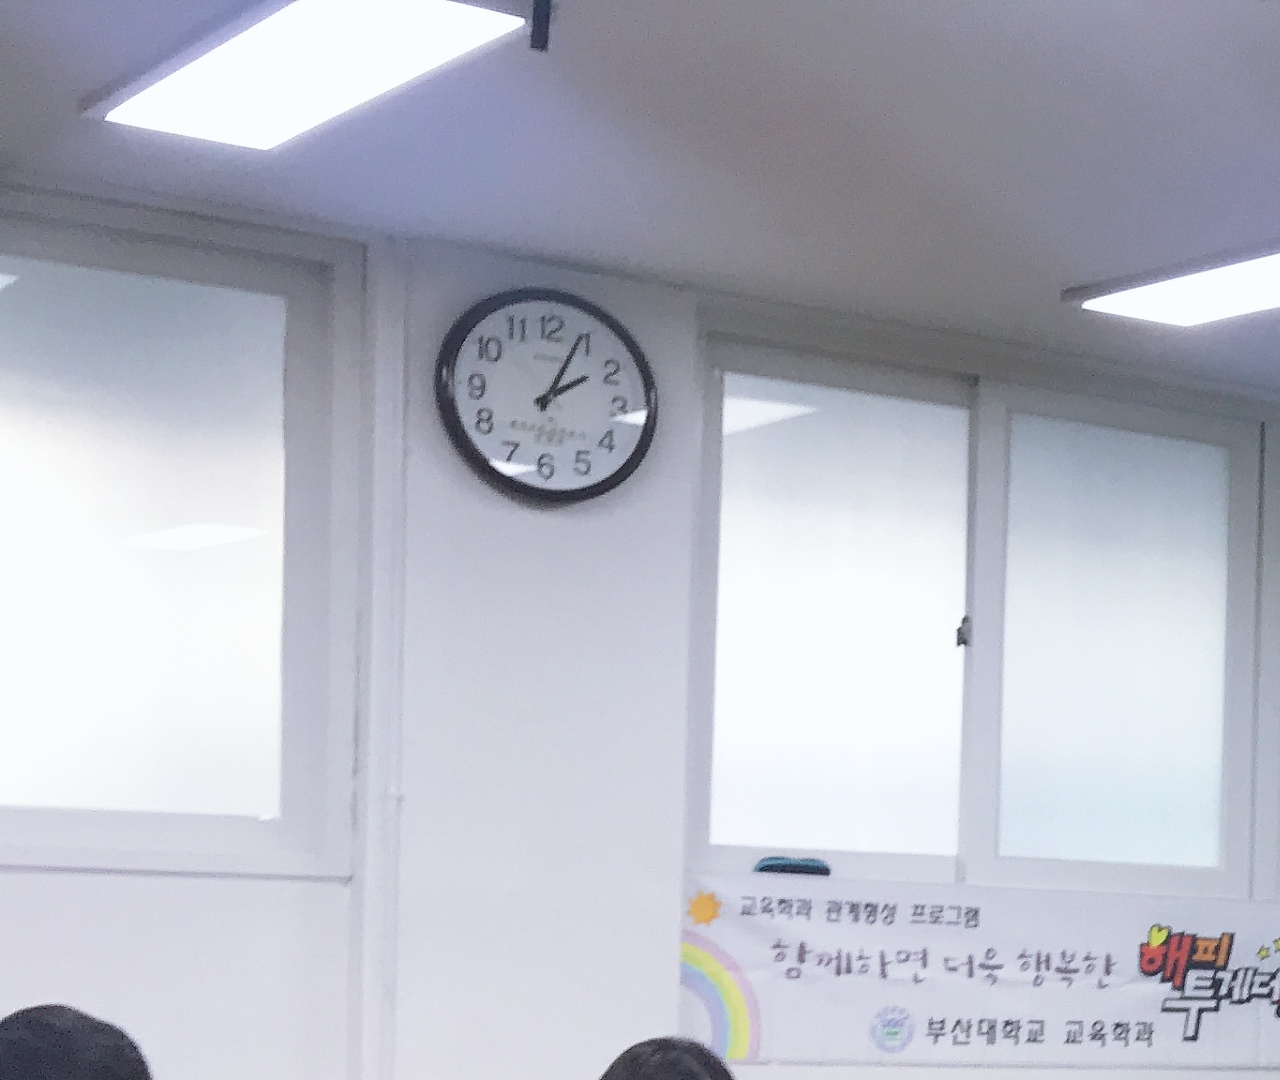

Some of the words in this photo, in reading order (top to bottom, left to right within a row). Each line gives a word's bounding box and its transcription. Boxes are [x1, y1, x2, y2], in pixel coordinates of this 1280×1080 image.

[507, 315, 527, 342] 11
[540, 314, 565, 342] 12
[476, 336, 502, 362] 10
[603, 358, 621, 385] 2
[467, 373, 486, 400] 9
[610, 395, 628, 418] 3
[475, 407, 494, 435] 8
[502, 440, 520, 461] 7
[598, 429, 615, 453] 4
[536, 453, 555, 480] 6
[573, 450, 591, 476] 5
[740, 895, 813, 920] 교육학과
[910, 902, 981, 929] 프로그램
[770, 938, 929, 985] 함께하면
[944, 947, 1004, 987] 더욱
[1017, 948, 1117, 990] 행복한
[1139, 924, 1235, 991] 해피
[927, 1016, 1046, 1046] 부산대학교
[1064, 1020, 1154, 1049] 교육학과
